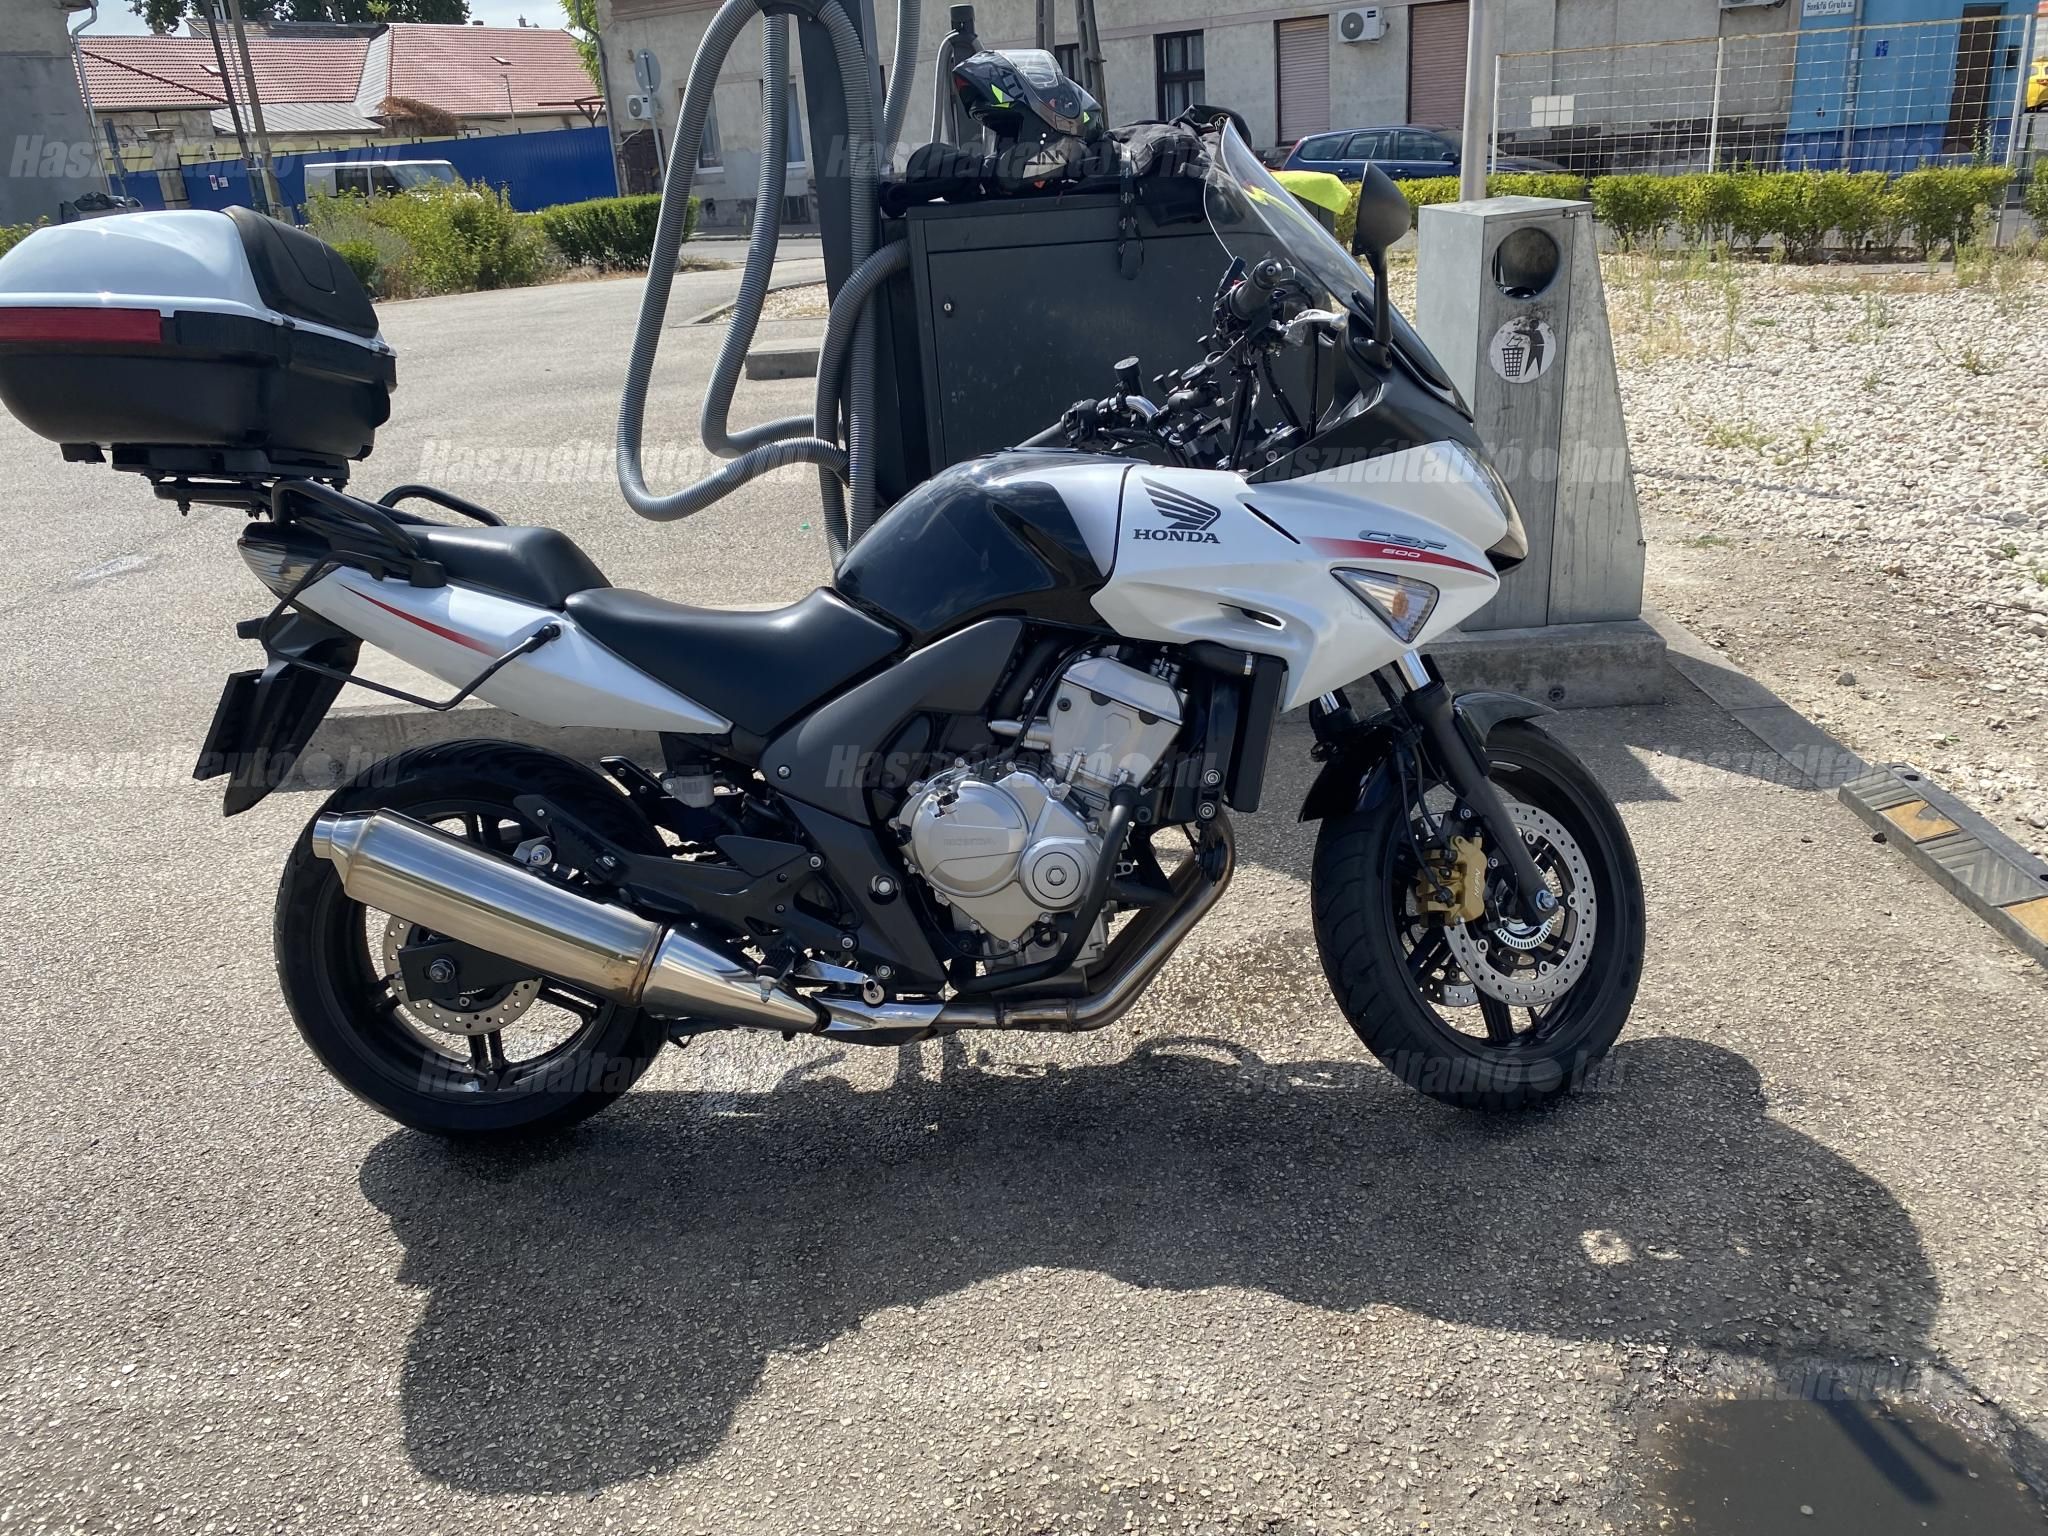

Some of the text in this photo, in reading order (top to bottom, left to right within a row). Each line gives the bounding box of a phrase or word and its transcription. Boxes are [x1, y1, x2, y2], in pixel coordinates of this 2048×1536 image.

[1132, 528, 1222, 545] HONDA
[1358, 529, 1448, 550] CBF
[1381, 548, 1421, 559] 600
